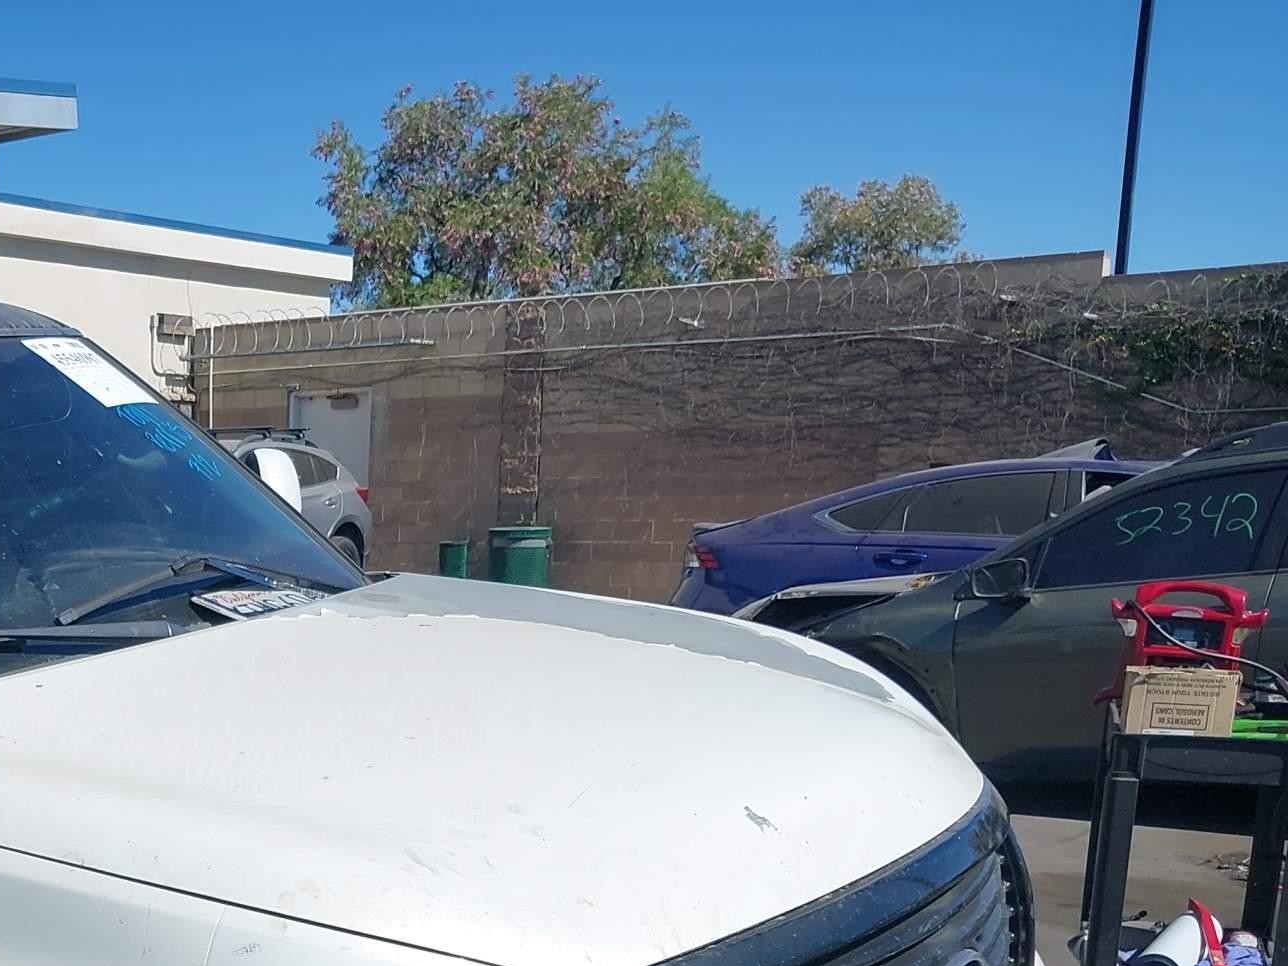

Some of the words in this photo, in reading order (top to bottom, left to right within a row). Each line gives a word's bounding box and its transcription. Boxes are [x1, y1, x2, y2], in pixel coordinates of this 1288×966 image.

[1115, 492, 1258, 546] 52342
[1155, 706, 1174, 715] CANS
[1175, 708, 1205, 717] AEROSOL
[1158, 716, 1166, 724] IN
[1166, 717, 1202, 726] CONTENTS
